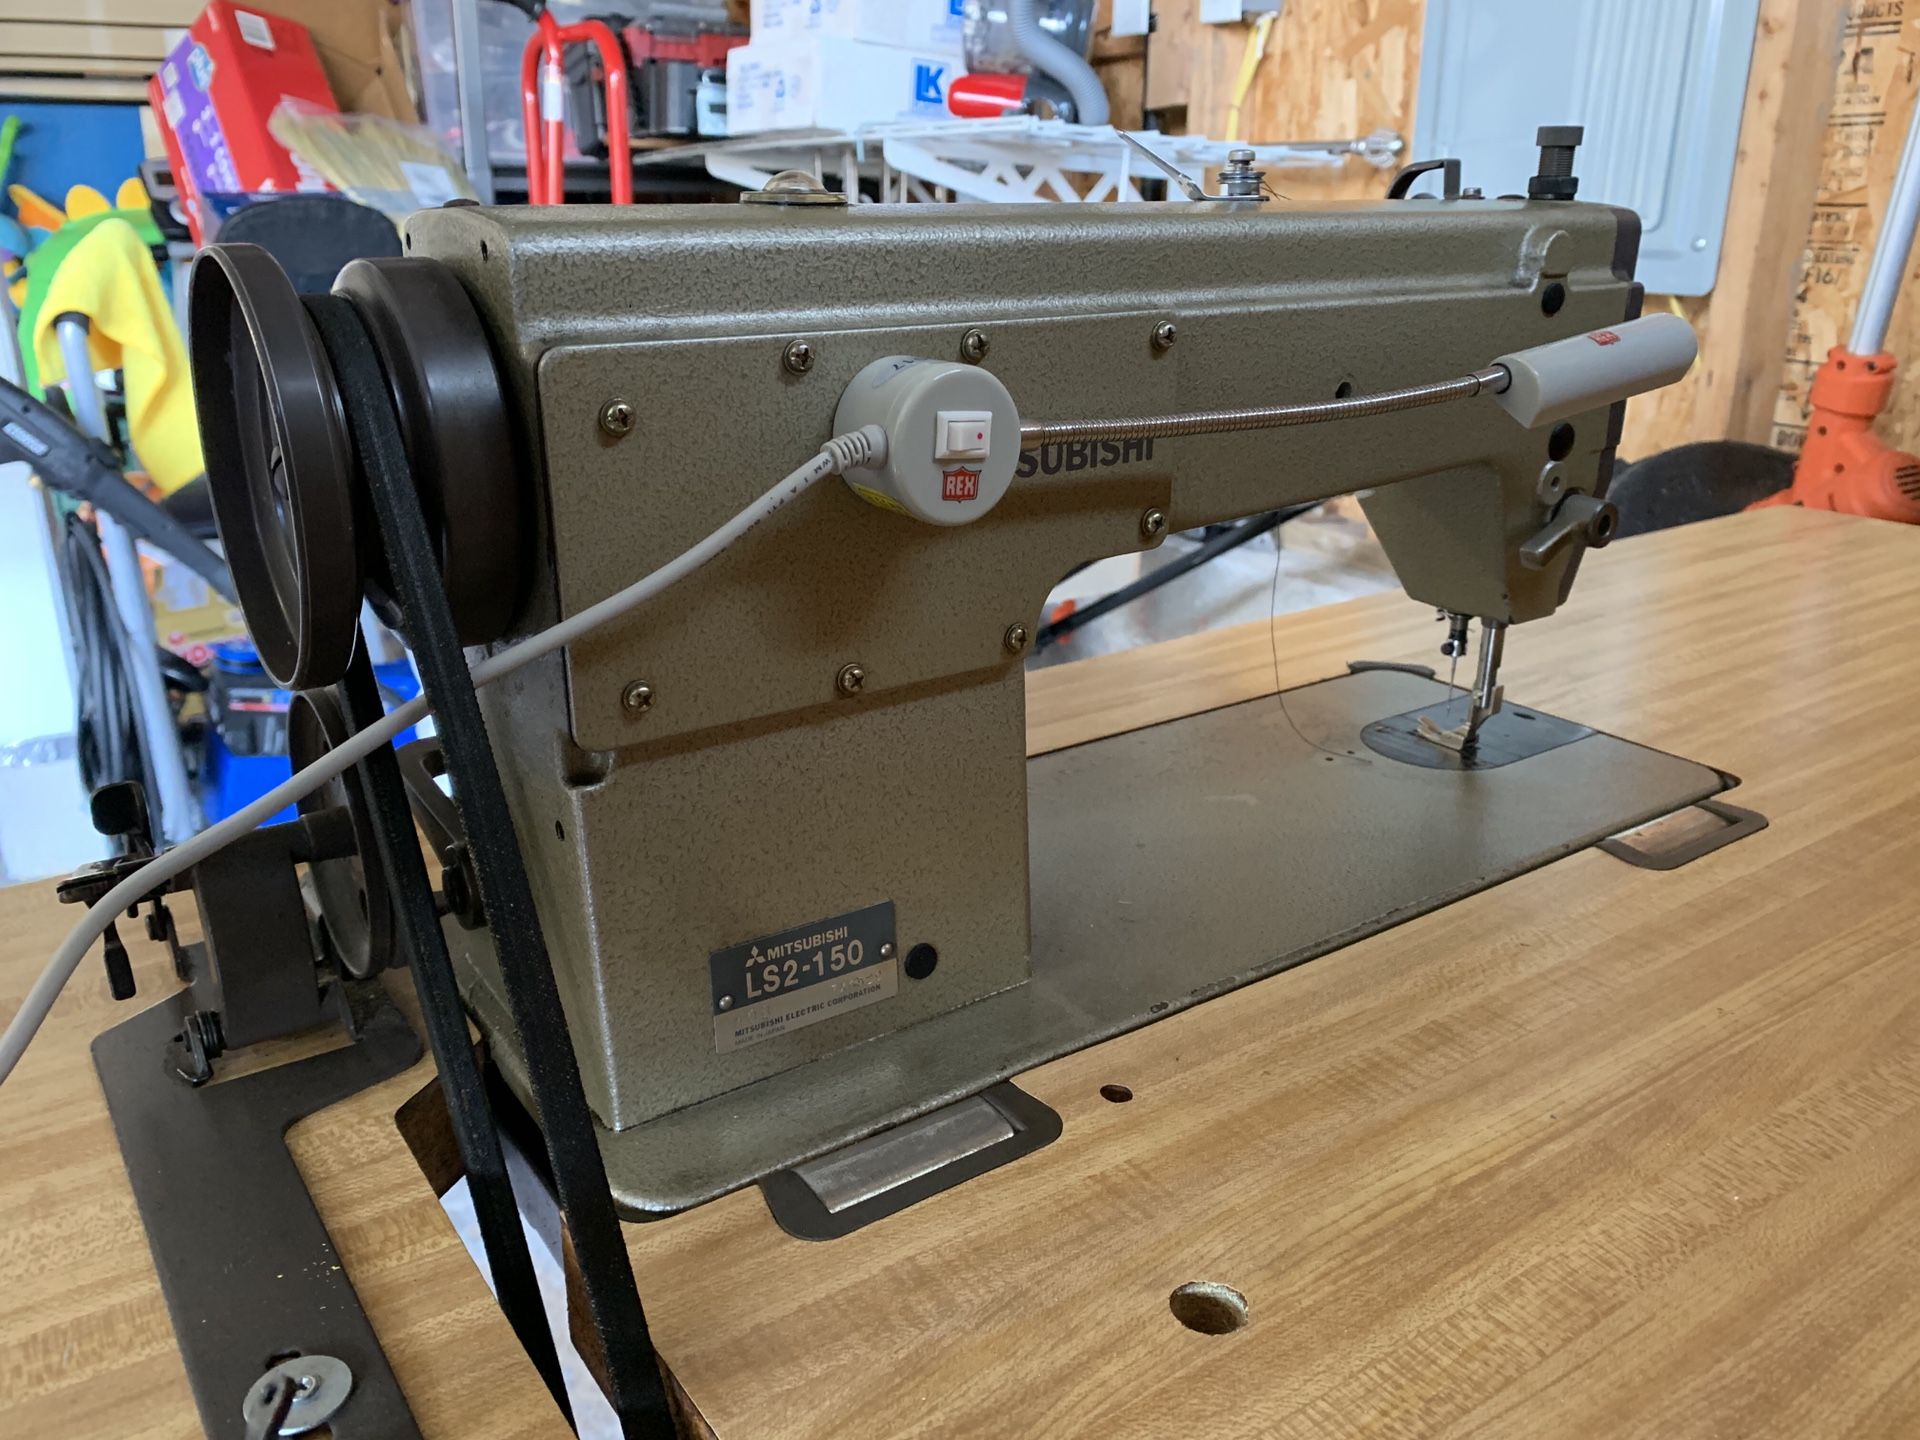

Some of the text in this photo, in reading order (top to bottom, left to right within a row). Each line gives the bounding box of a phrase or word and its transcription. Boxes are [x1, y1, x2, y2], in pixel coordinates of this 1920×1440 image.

[916, 65, 943, 104] LK
[946, 476, 975, 496] REX
[767, 926, 848, 961] MITSUBISHI
[746, 939, 863, 998] LS2-150
[735, 1016, 784, 1037] MITSUBISHI
[785, 1002, 825, 1021] ELECTRIC
[827, 983, 881, 1008] CORPORATION
